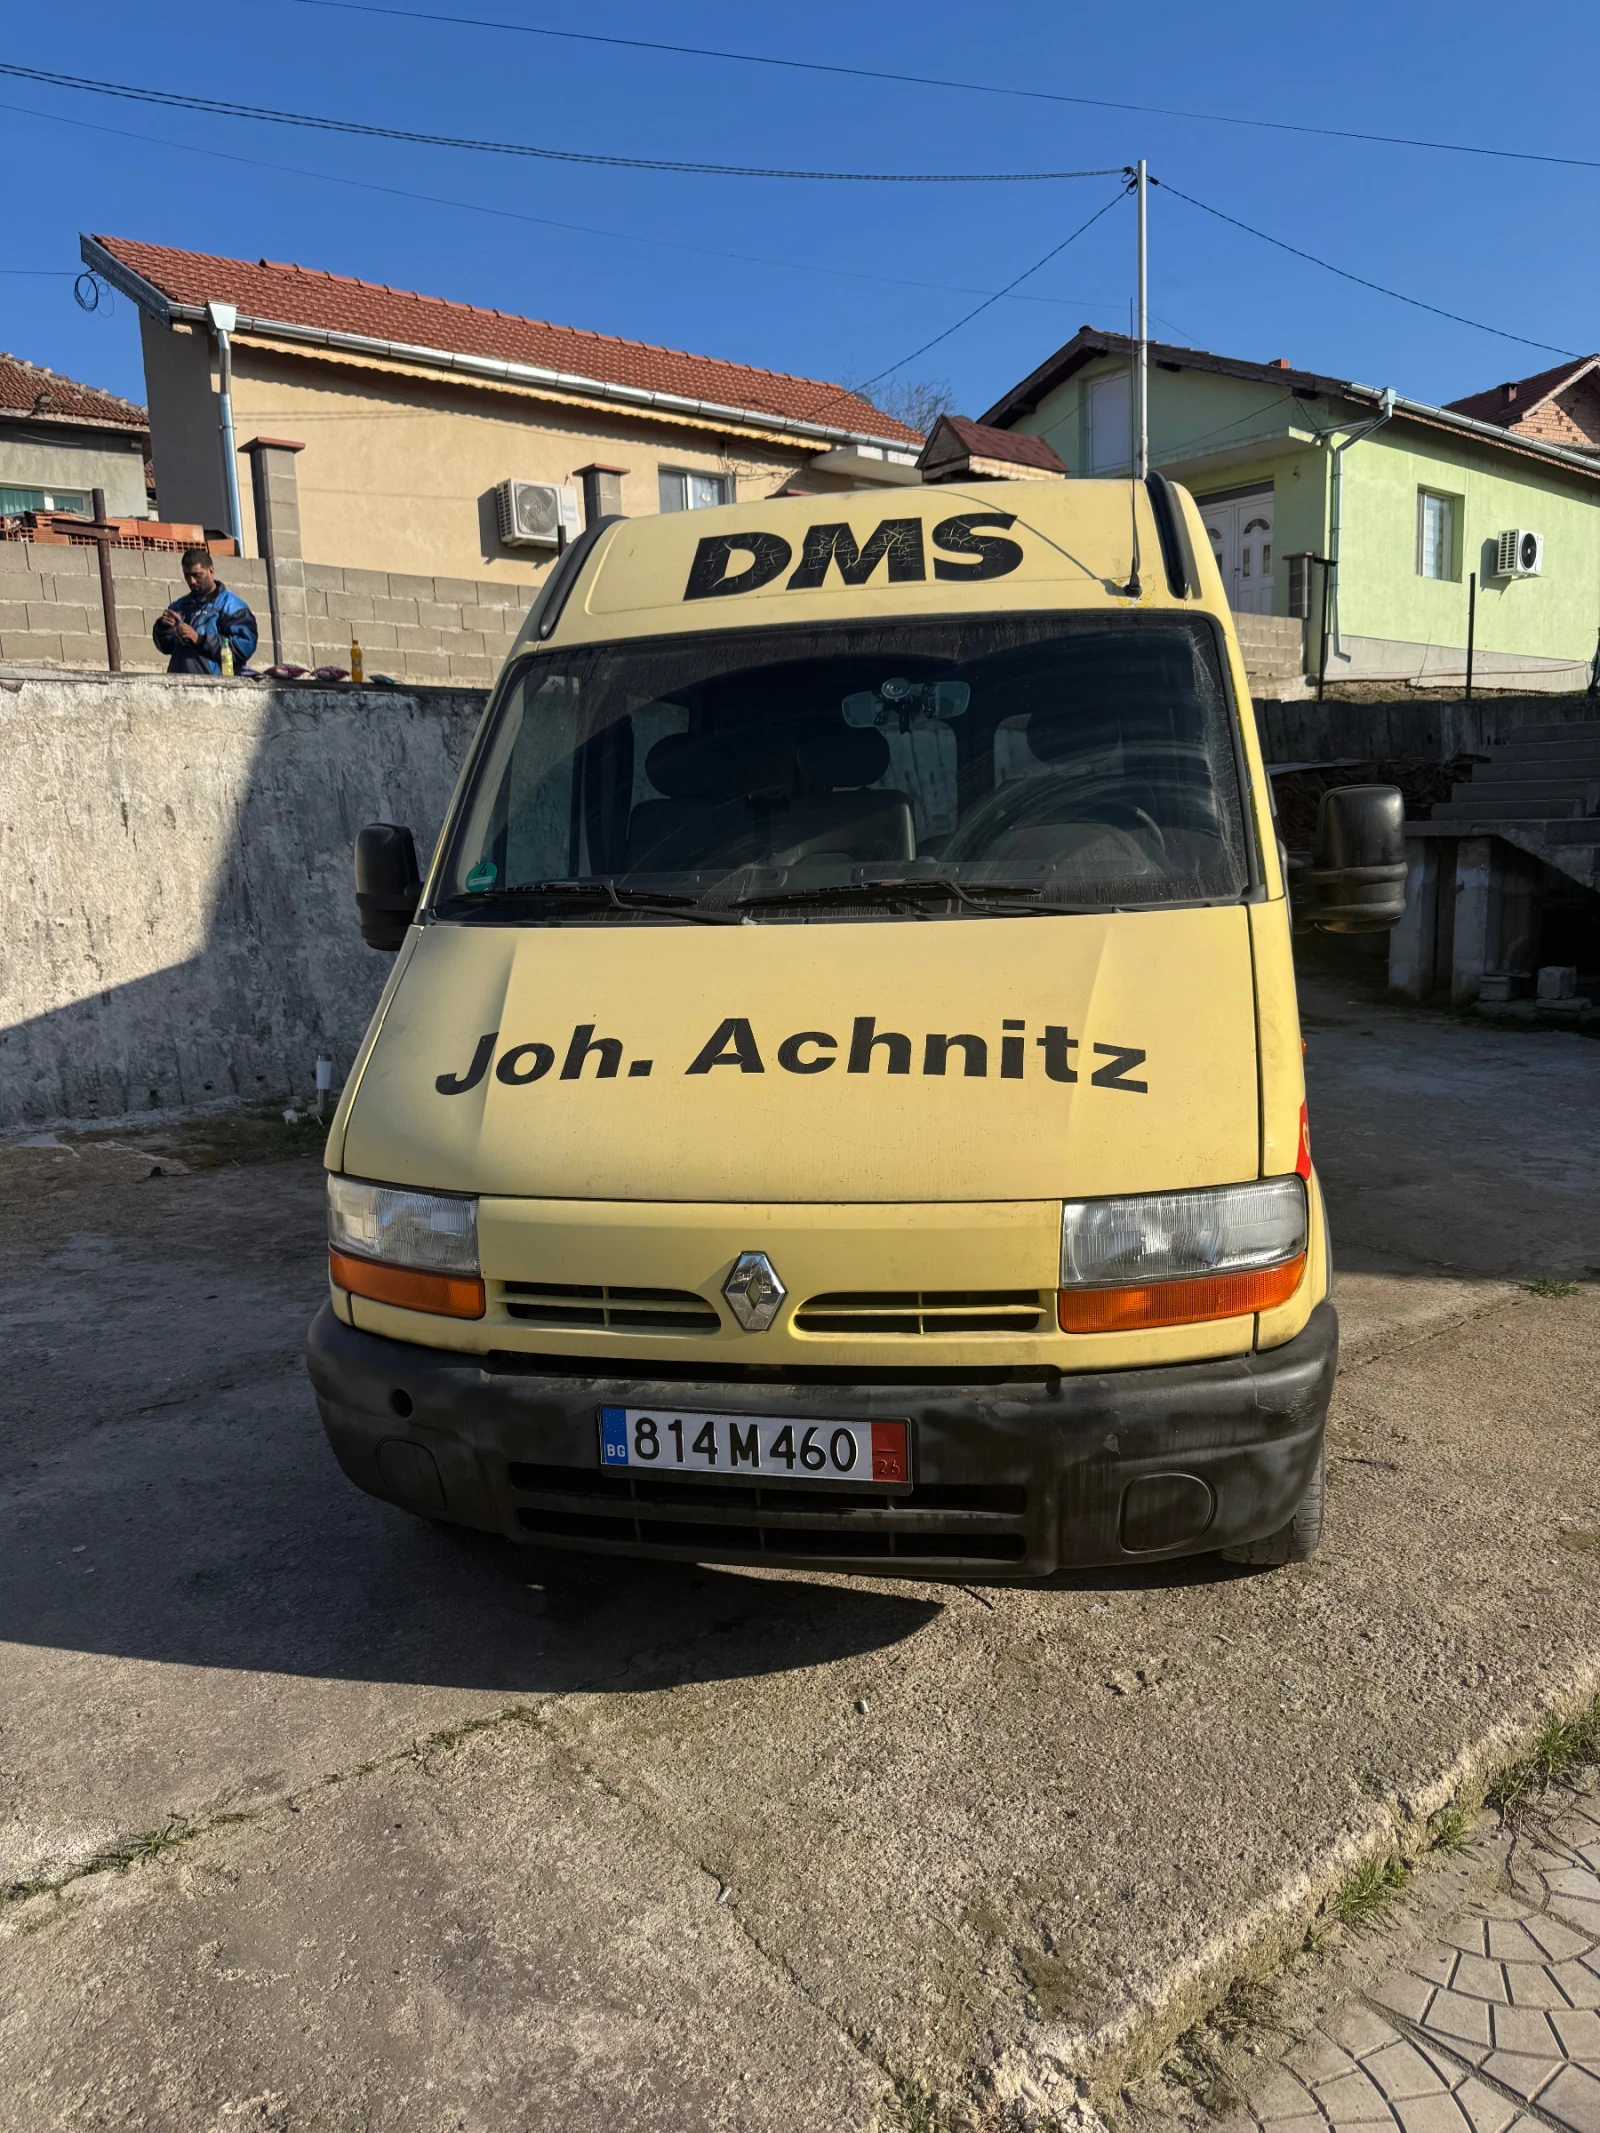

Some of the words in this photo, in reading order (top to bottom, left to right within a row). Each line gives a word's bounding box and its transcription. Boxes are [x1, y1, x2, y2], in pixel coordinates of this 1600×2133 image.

[683, 512, 1024, 601] DMS
[435, 1024, 653, 1095] Joh.
[685, 1016, 1148, 1094] Achnitz
[607, 1444, 626, 1457] BG
